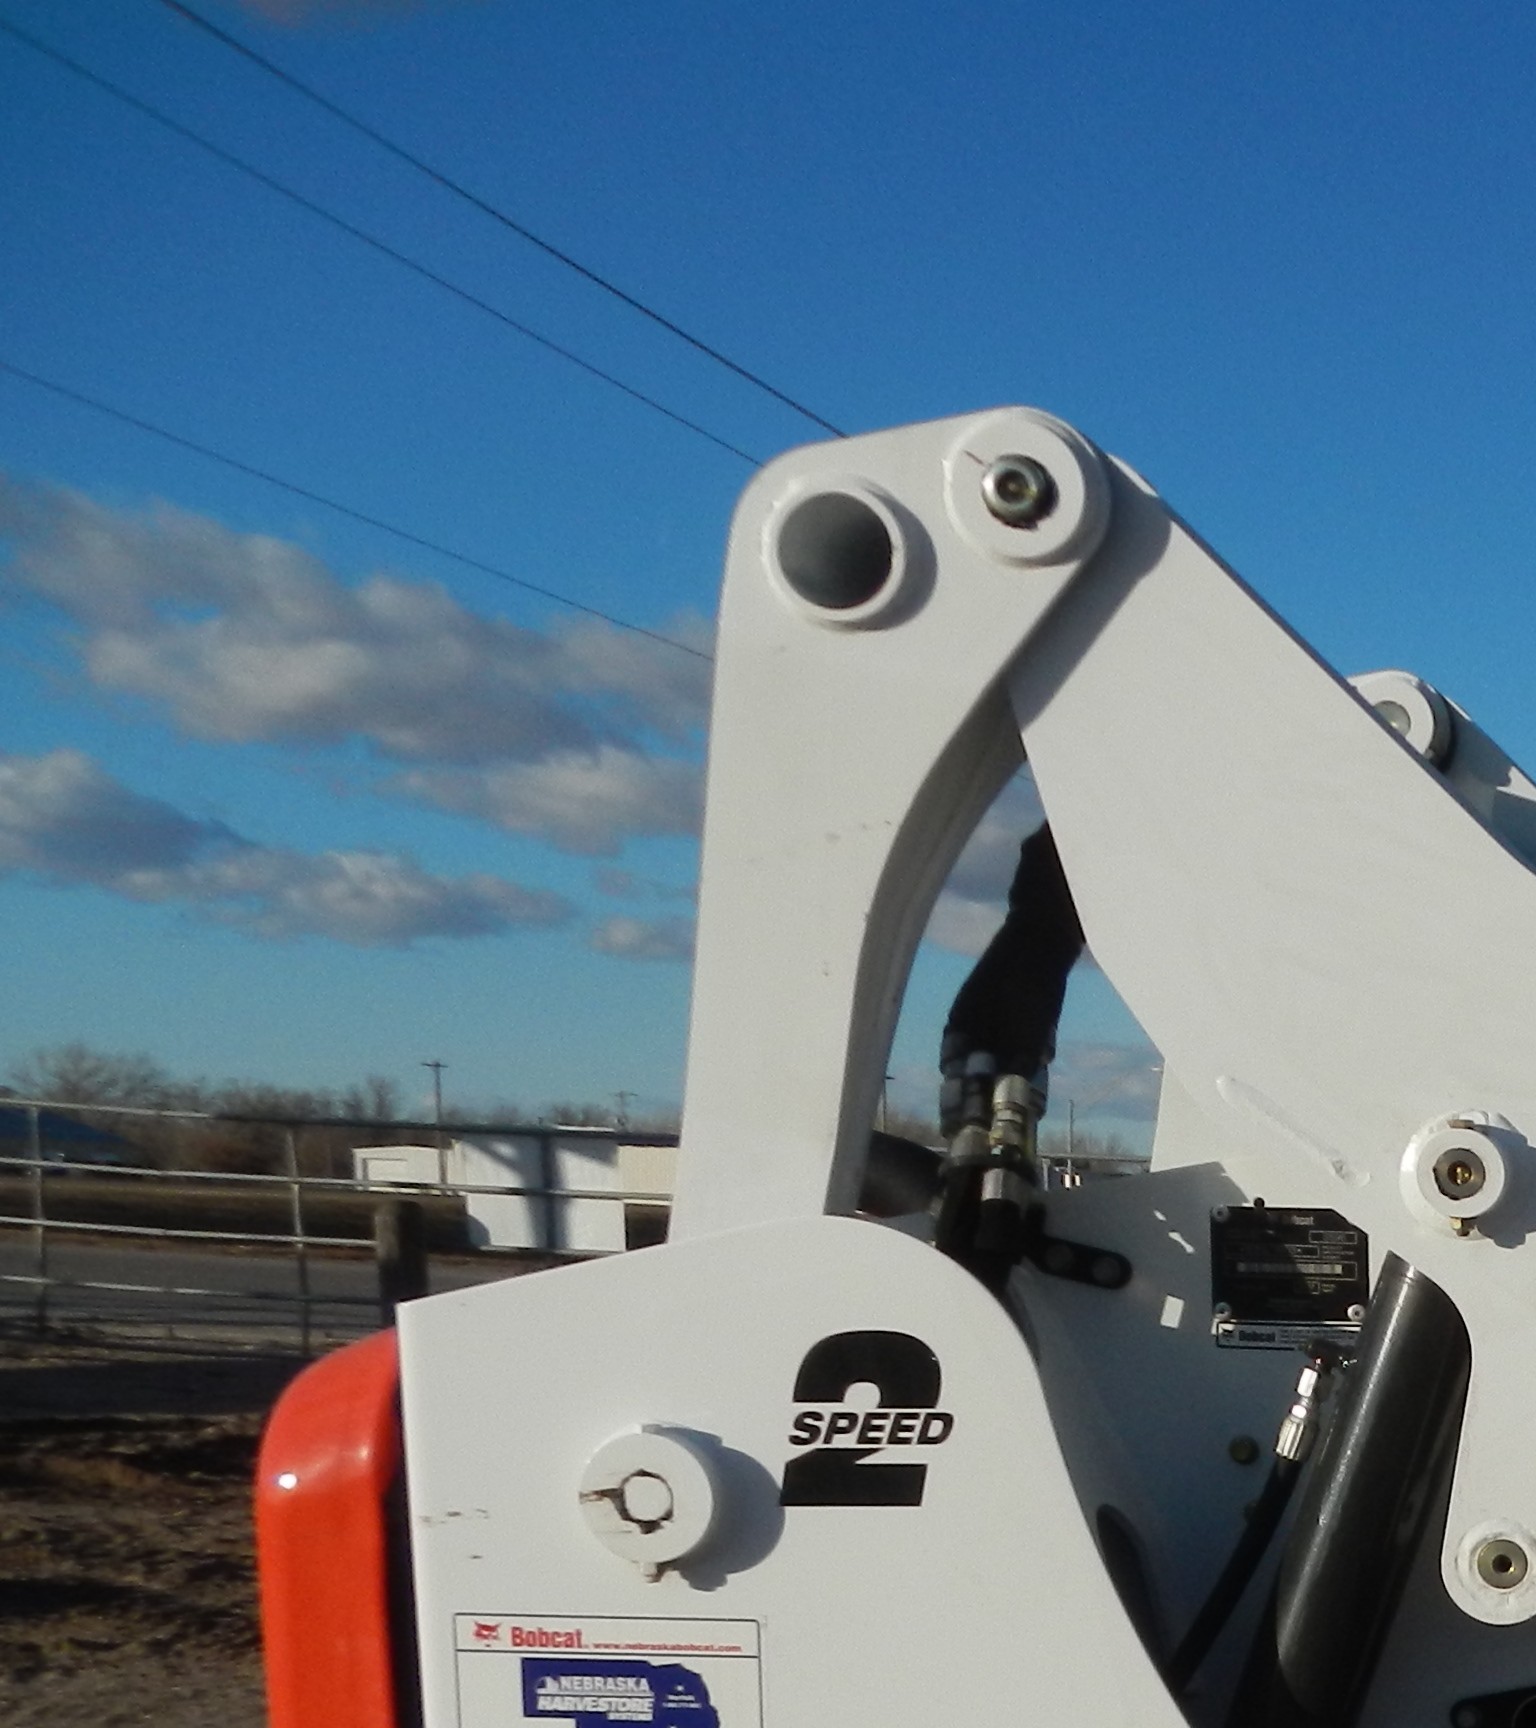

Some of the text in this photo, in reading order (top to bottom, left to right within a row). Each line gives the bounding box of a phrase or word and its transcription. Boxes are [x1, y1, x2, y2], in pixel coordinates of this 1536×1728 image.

[780, 1330, 942, 1507] 2
[788, 1411, 954, 1446] SPEED
[511, 1627, 742, 1653] Bobcat www.nebraskabobcat.com
[559, 1676, 651, 1694] NEBRASKA
[536, 1697, 654, 1713] HARVESTORE
